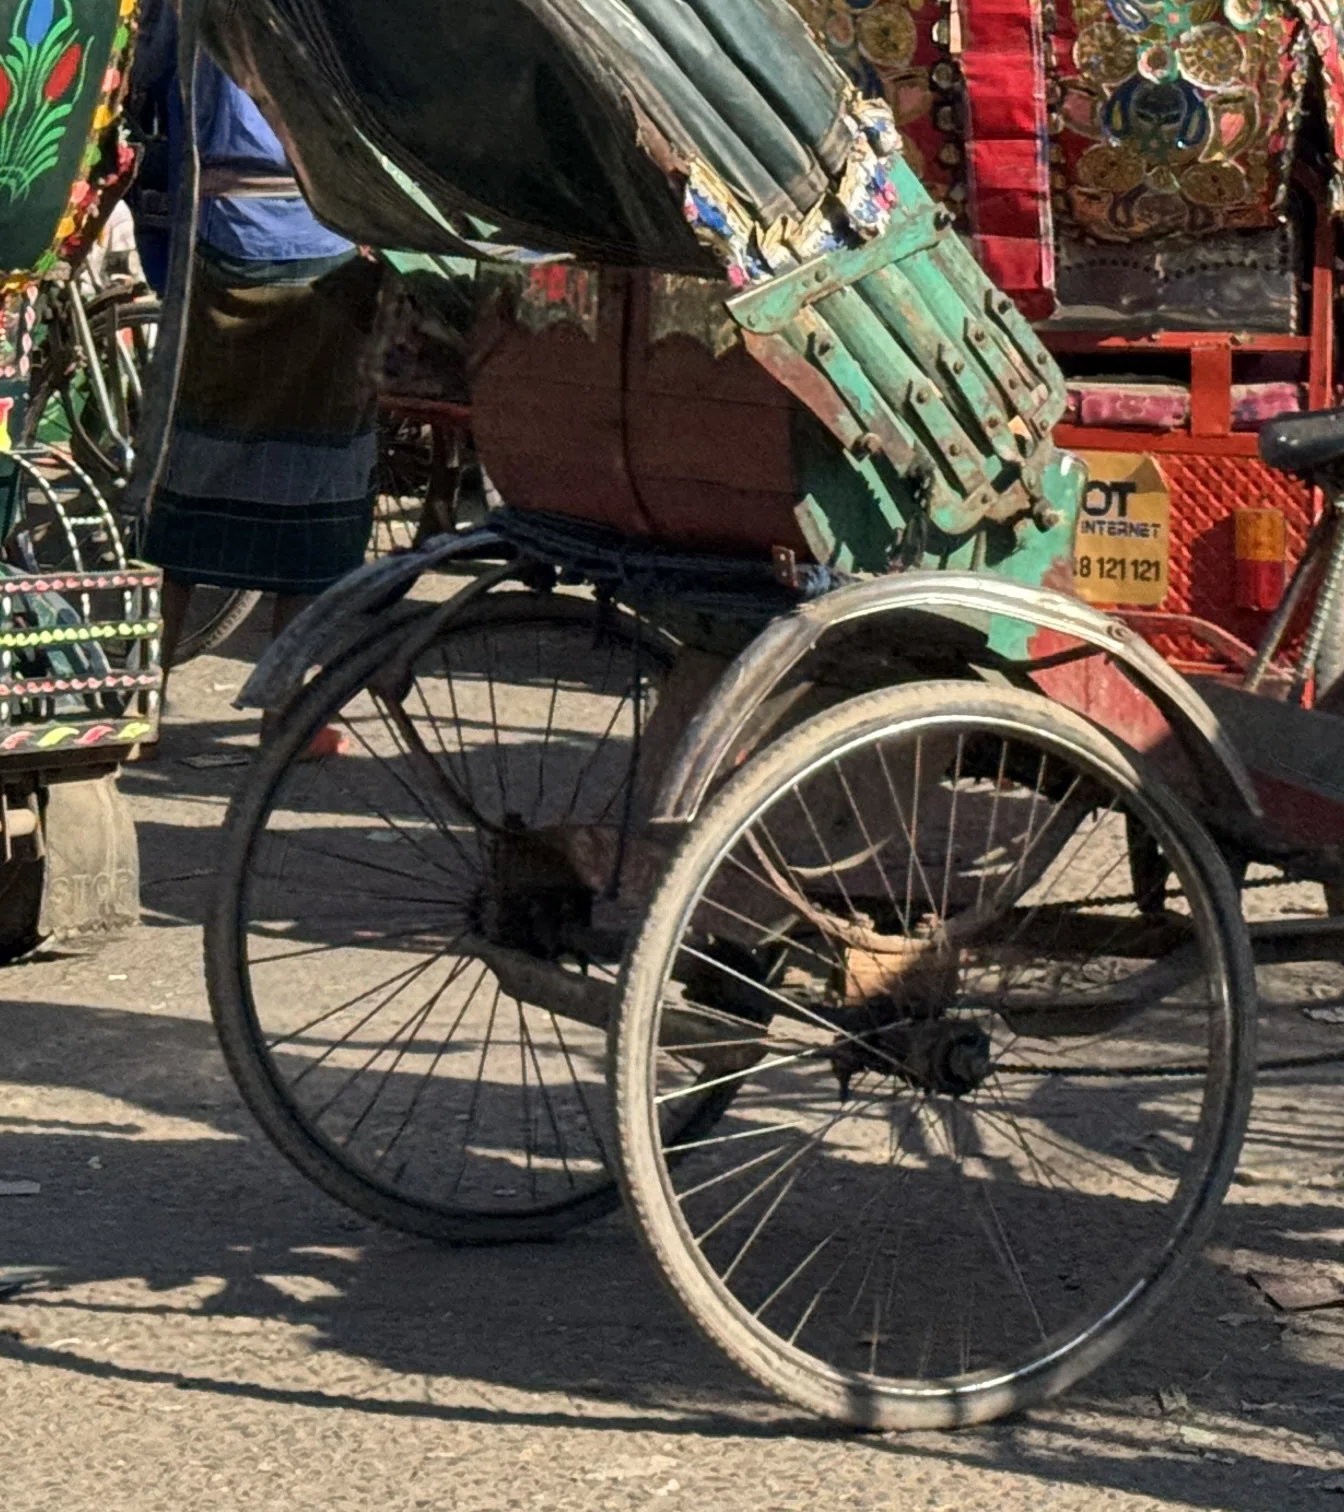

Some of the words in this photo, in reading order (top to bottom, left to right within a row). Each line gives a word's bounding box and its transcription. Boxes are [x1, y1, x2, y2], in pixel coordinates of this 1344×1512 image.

[1080, 480, 1137, 518] OT
[1096, 556, 1126, 580] 121
[1130, 559, 1161, 582] 121
